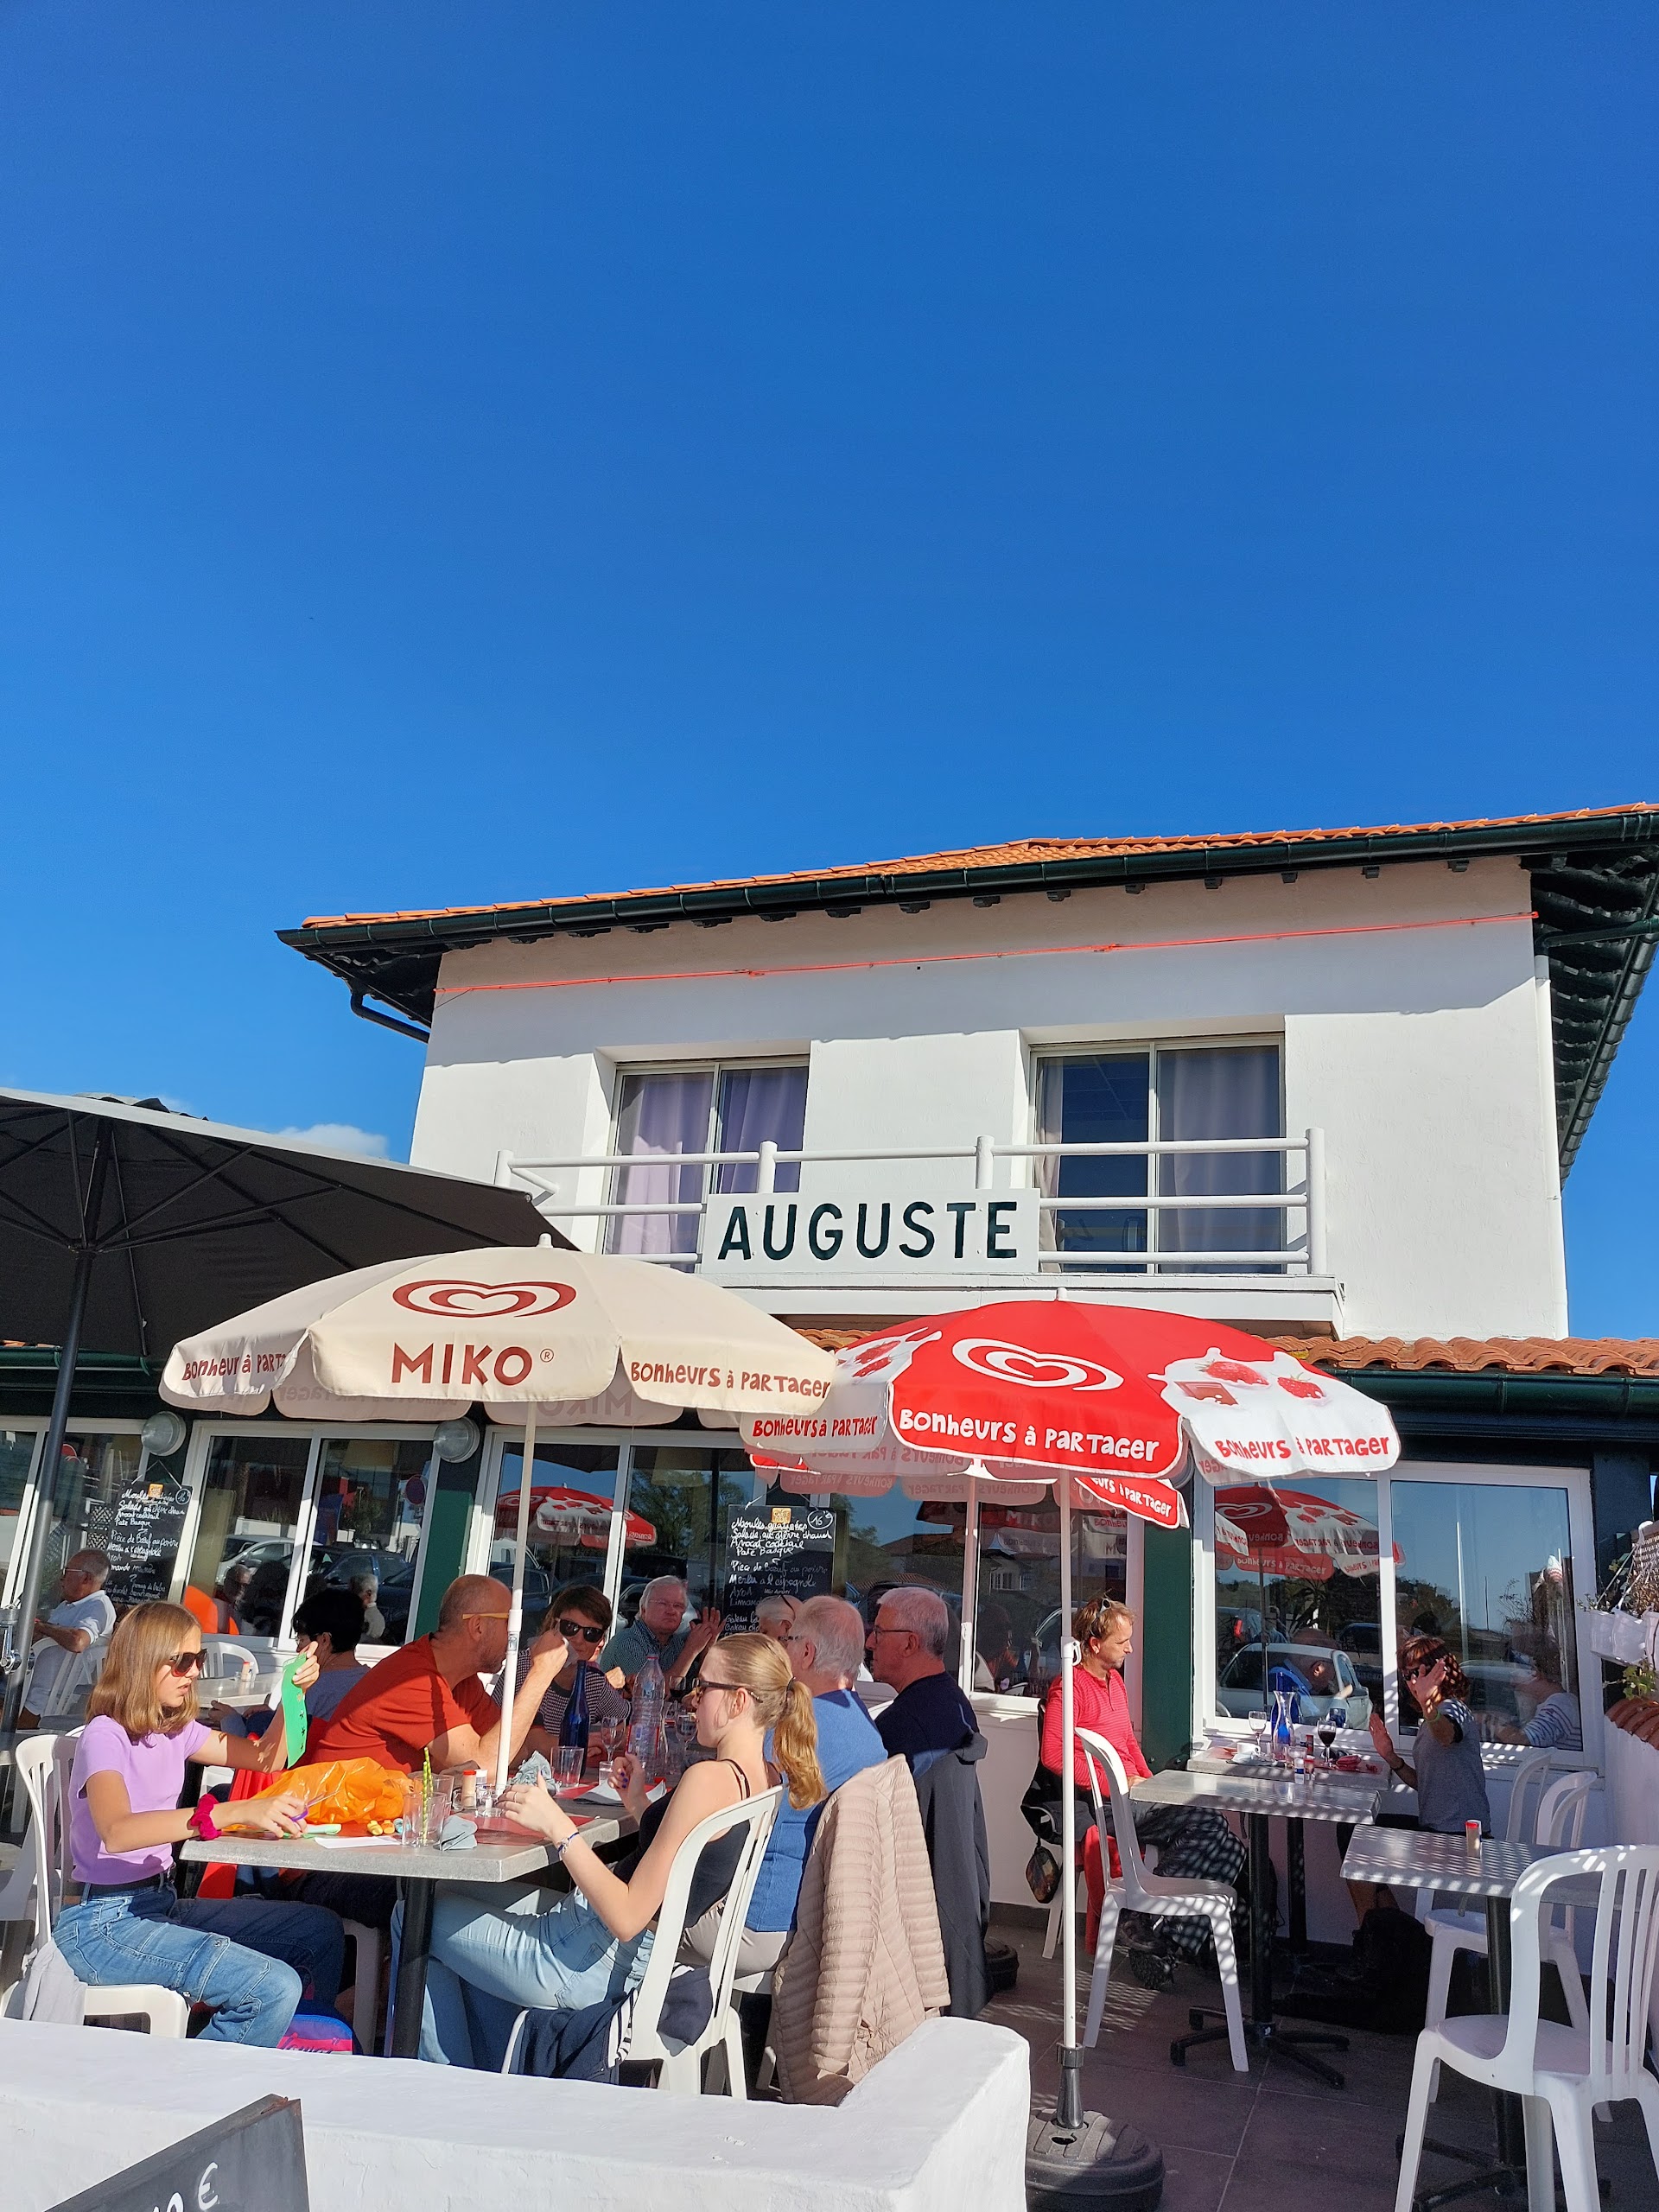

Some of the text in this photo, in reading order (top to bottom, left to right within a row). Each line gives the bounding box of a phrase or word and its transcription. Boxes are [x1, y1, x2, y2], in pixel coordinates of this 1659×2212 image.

[717, 1201, 1017, 1261] AUGUSTE
[391, 1342, 532, 1386] MIKO
[1024, 1426, 1037, 1446] à
